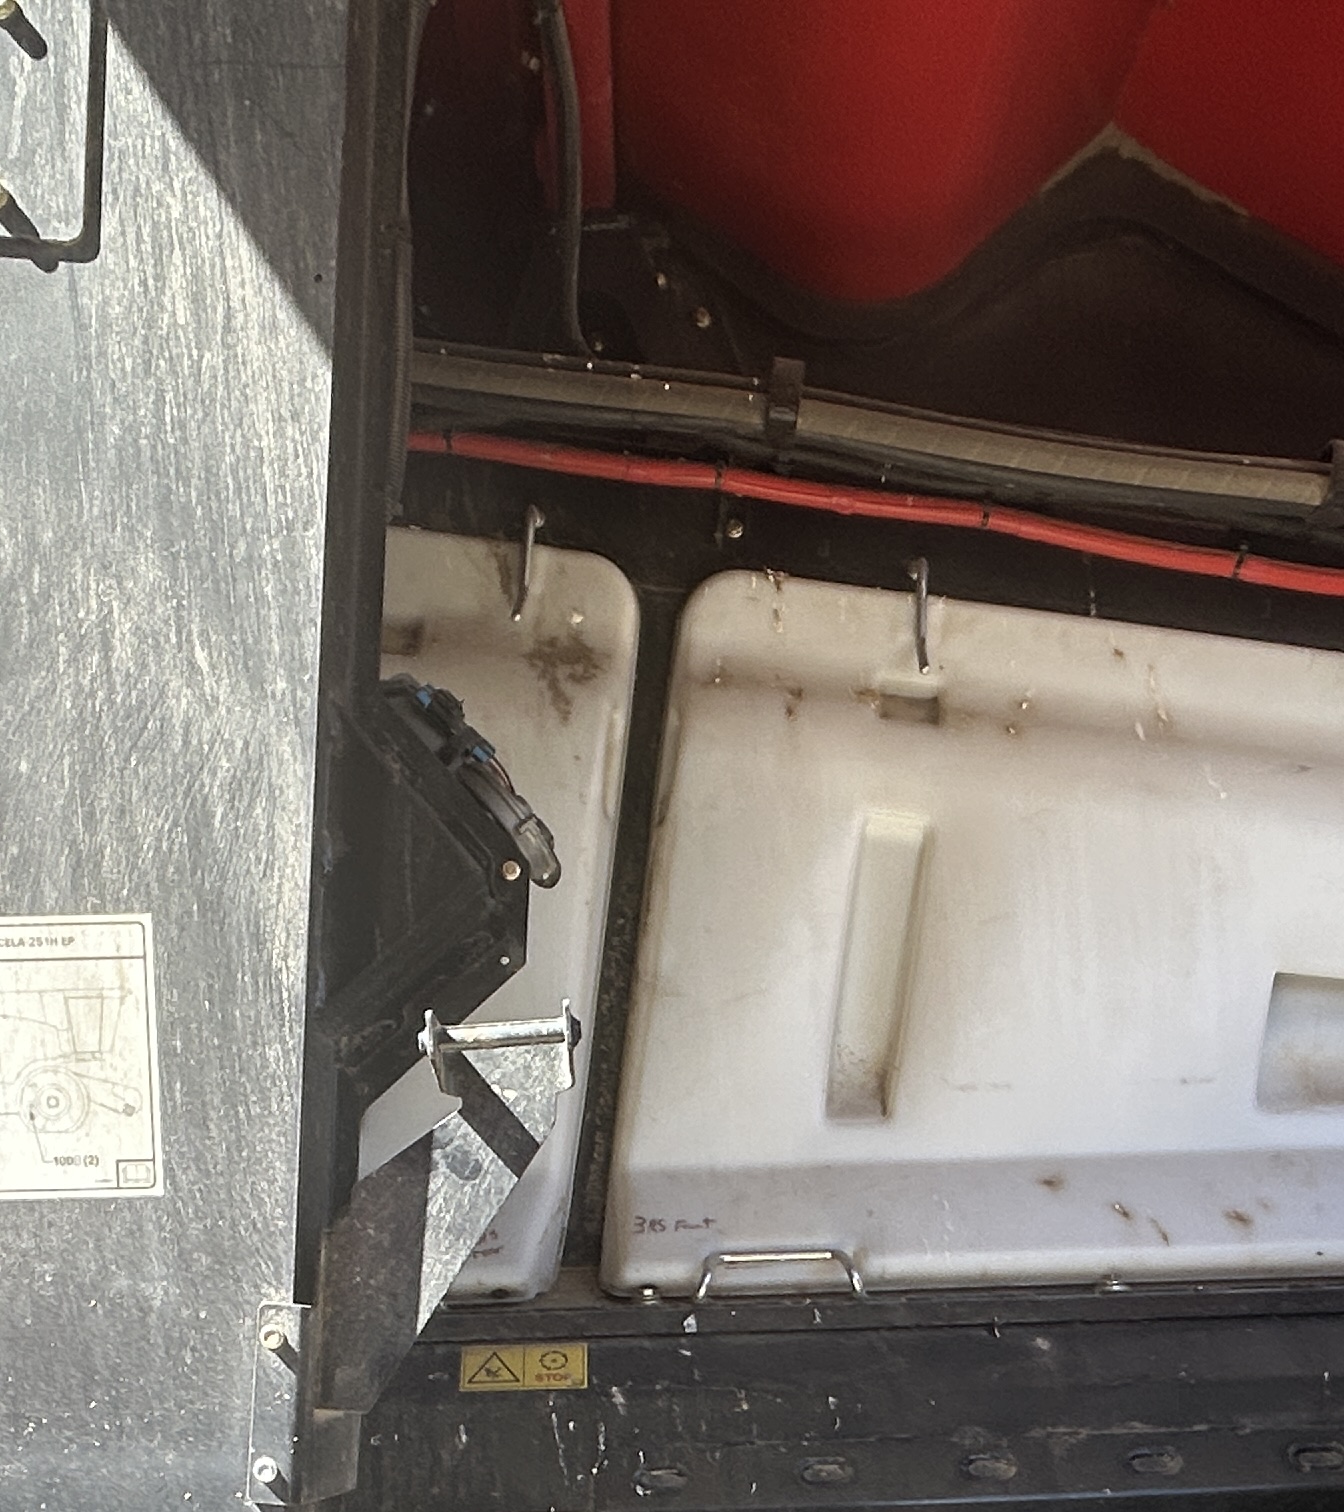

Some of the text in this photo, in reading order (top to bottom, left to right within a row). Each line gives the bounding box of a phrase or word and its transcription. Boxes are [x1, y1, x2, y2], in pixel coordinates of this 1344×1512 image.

[53, 1154, 99, 1168] 100 (2)
[534, 1372, 572, 1383] STOP
